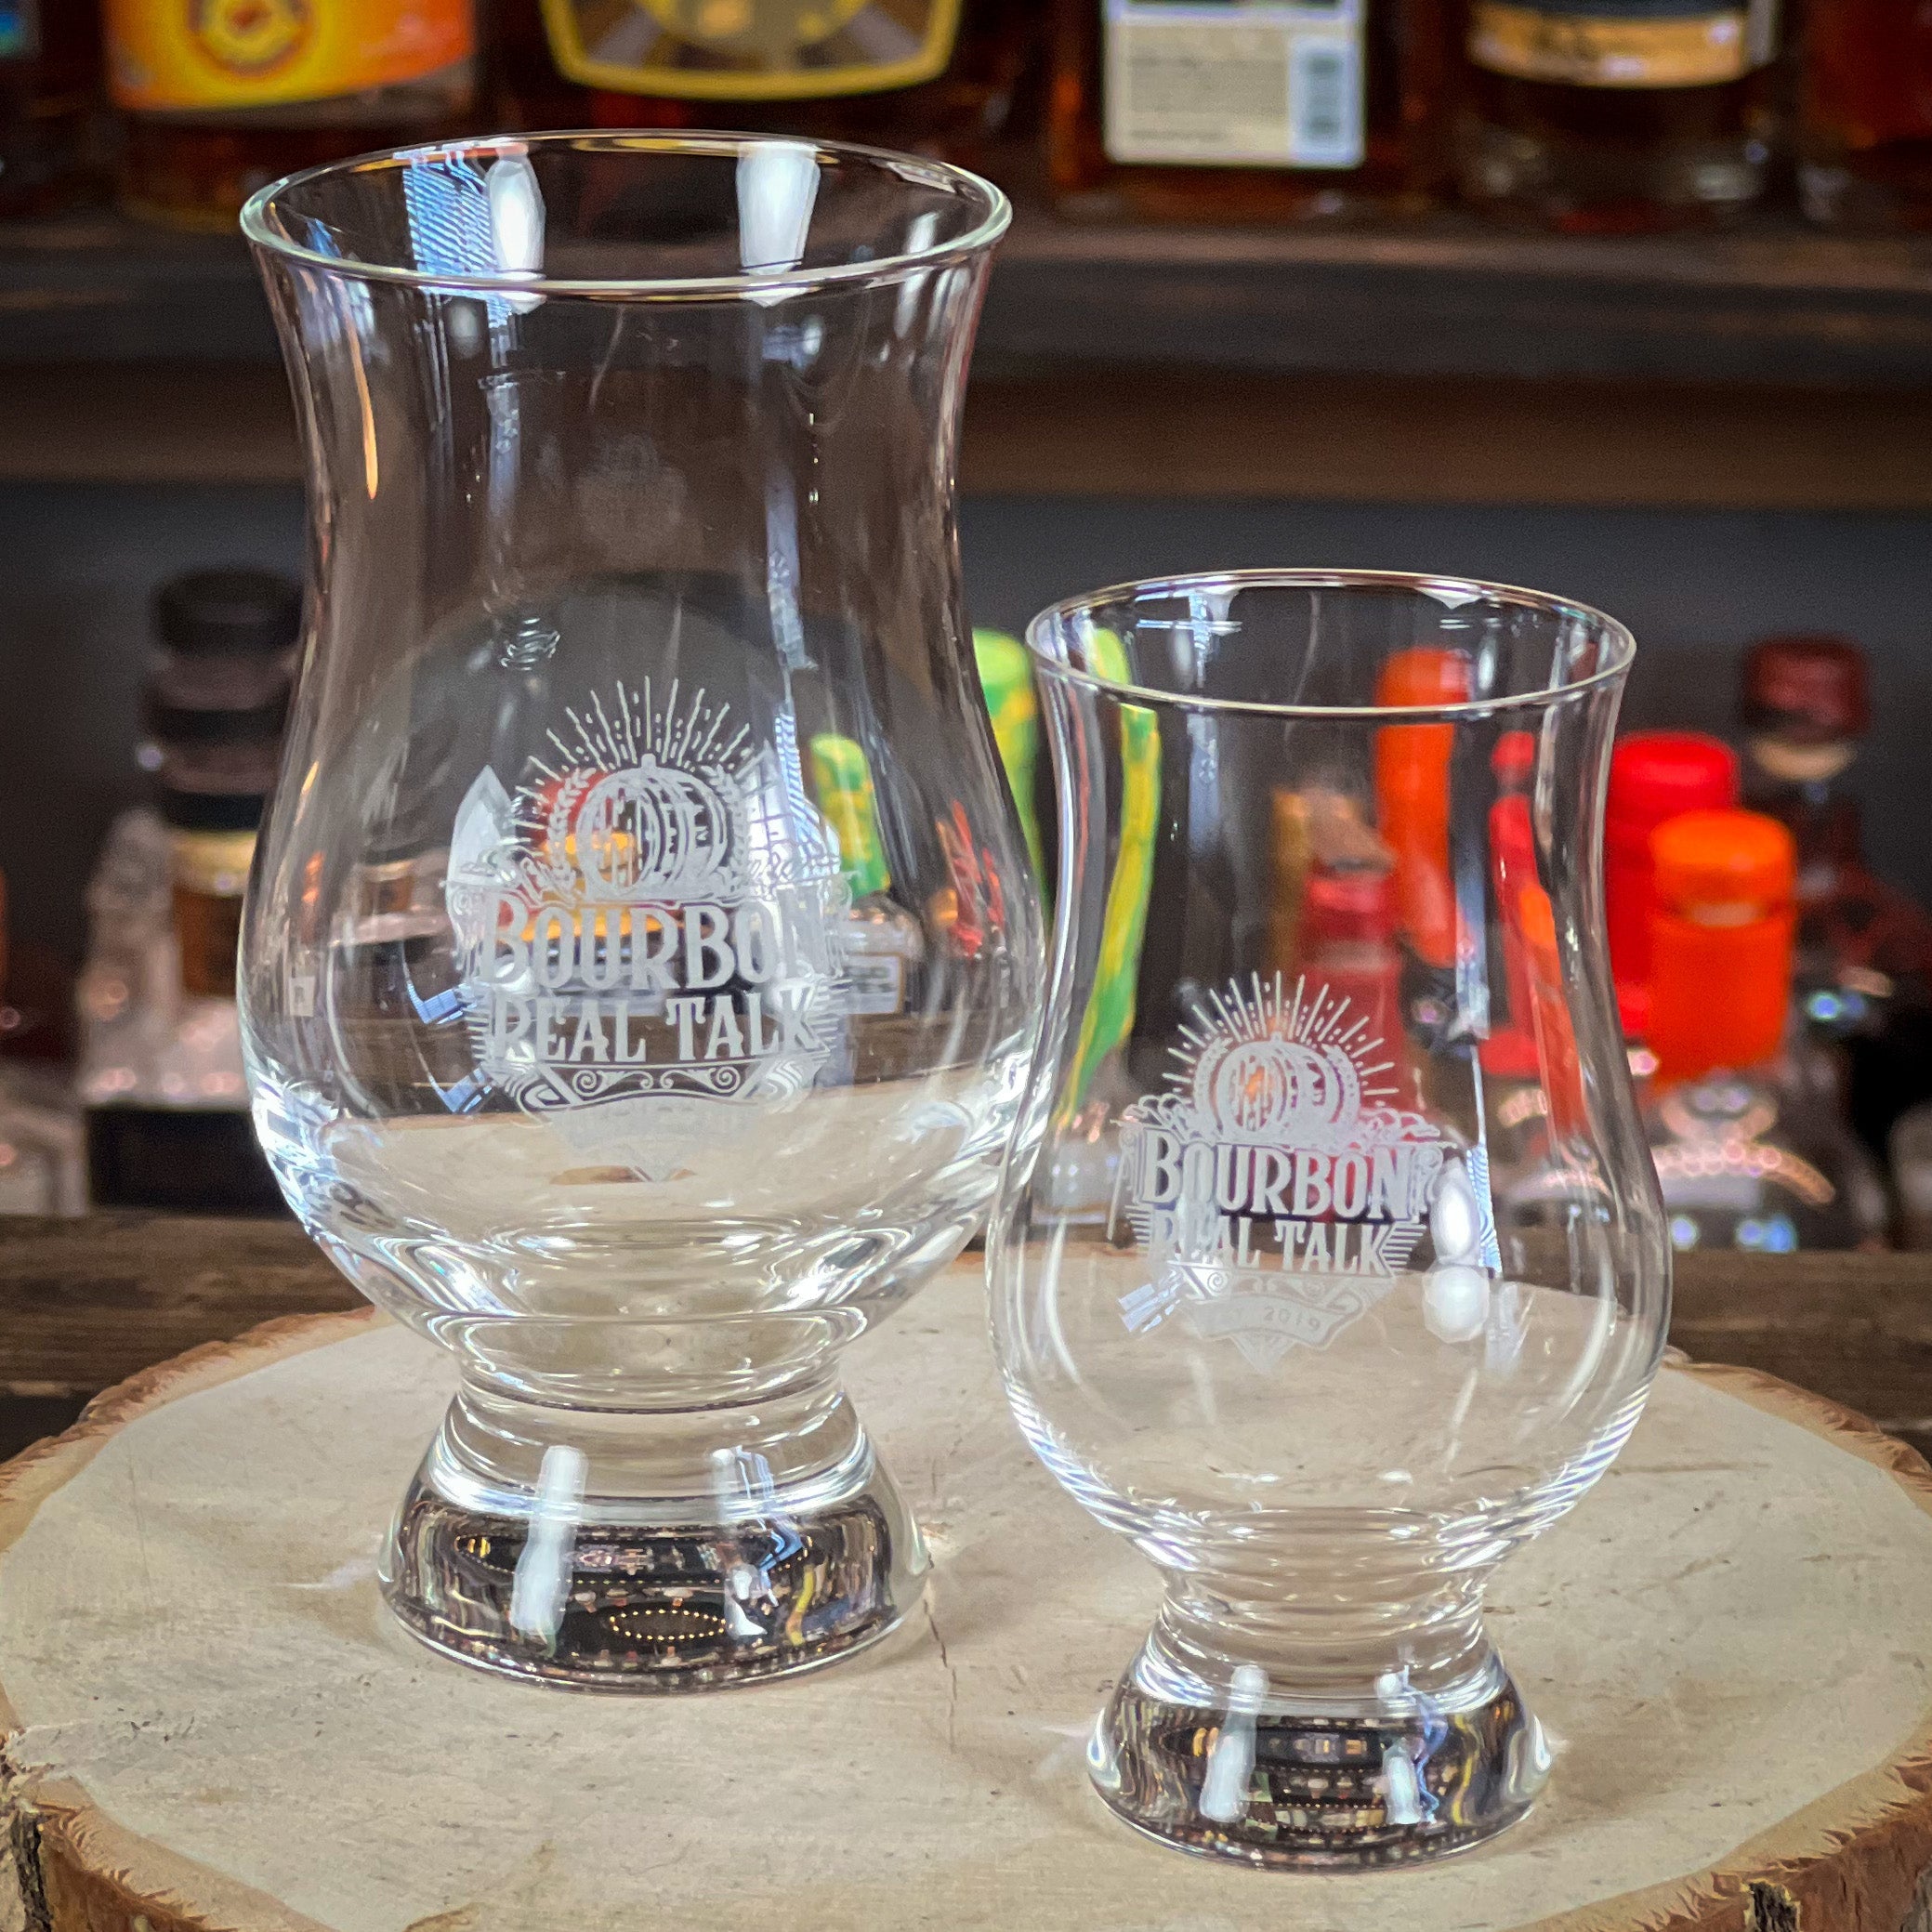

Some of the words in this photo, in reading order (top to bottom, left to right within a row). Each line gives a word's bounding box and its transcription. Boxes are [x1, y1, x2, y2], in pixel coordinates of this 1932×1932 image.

[494, 992, 647, 1062] REAL
[665, 982, 821, 1060] TALK
[1143, 1131, 1410, 1219] BOURBON
[1274, 1217, 1387, 1274] TALK
